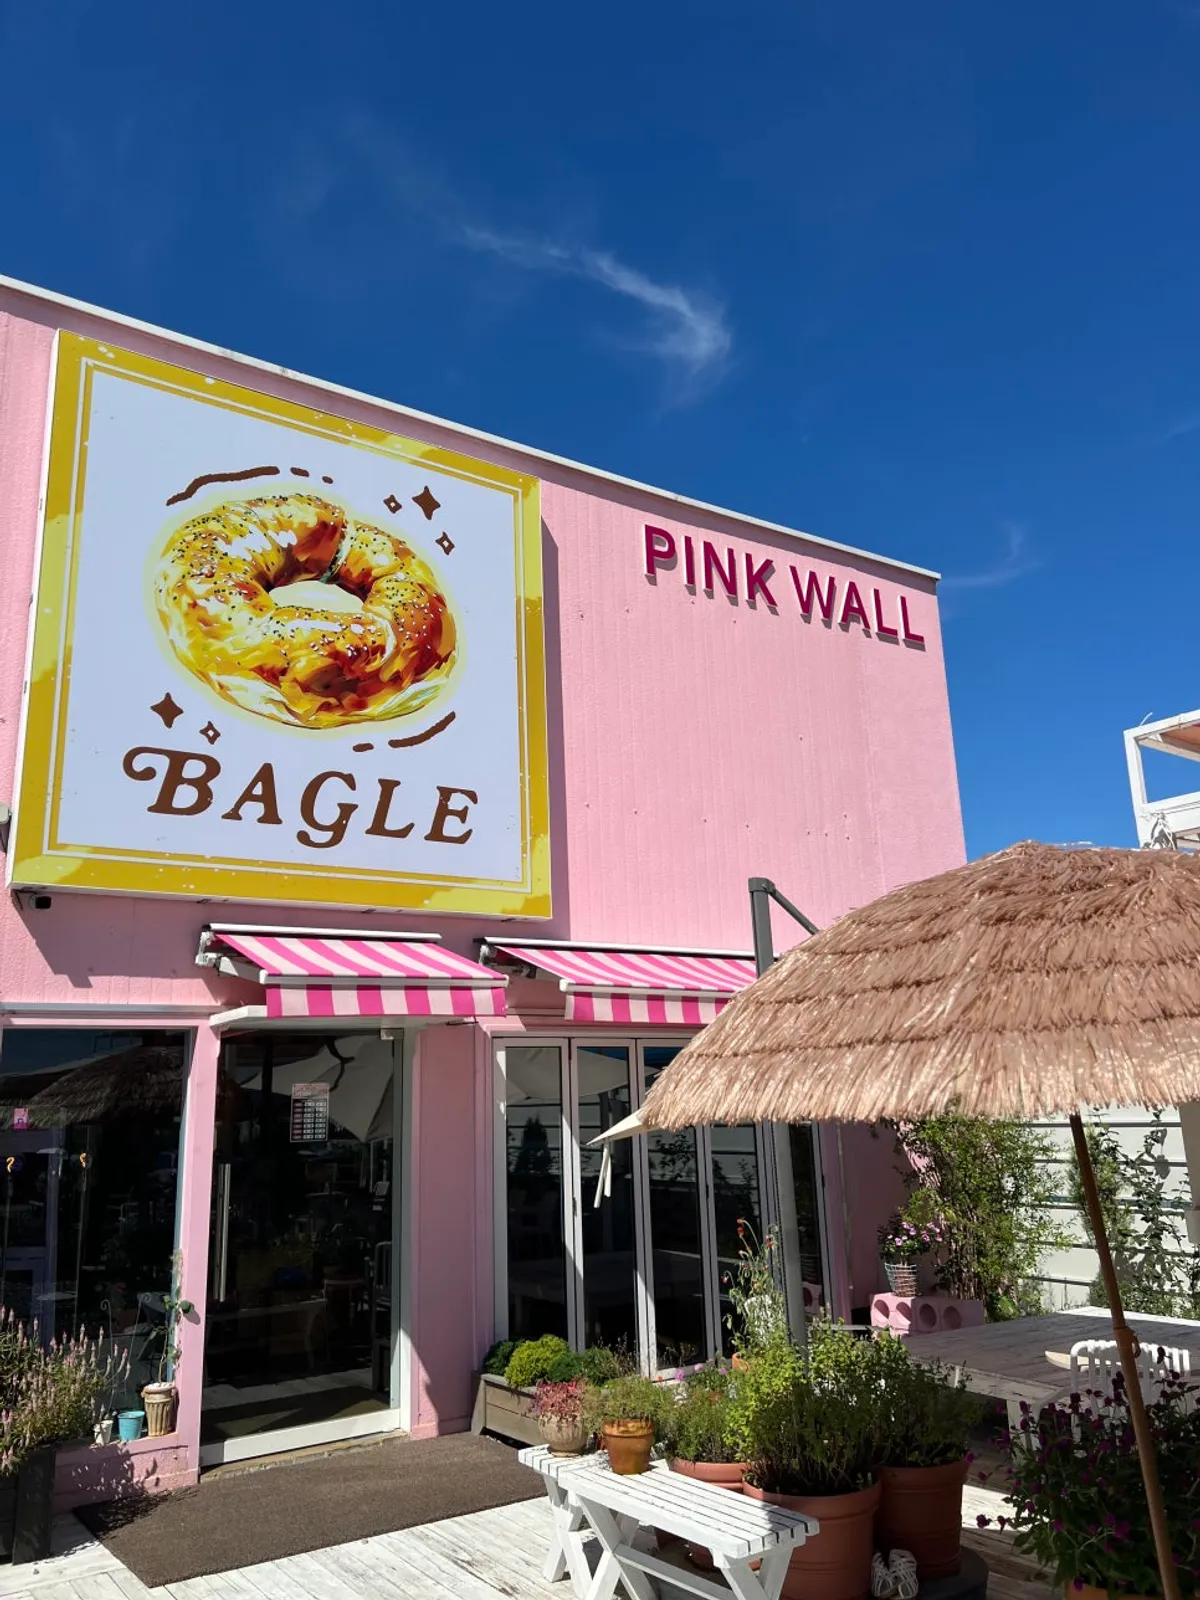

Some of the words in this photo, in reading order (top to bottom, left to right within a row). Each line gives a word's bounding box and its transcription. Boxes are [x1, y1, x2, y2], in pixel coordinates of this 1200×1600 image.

[643, 524, 778, 608] PINK
[789, 565, 925, 643] WALL
[122, 746, 479, 849] BAGLE
